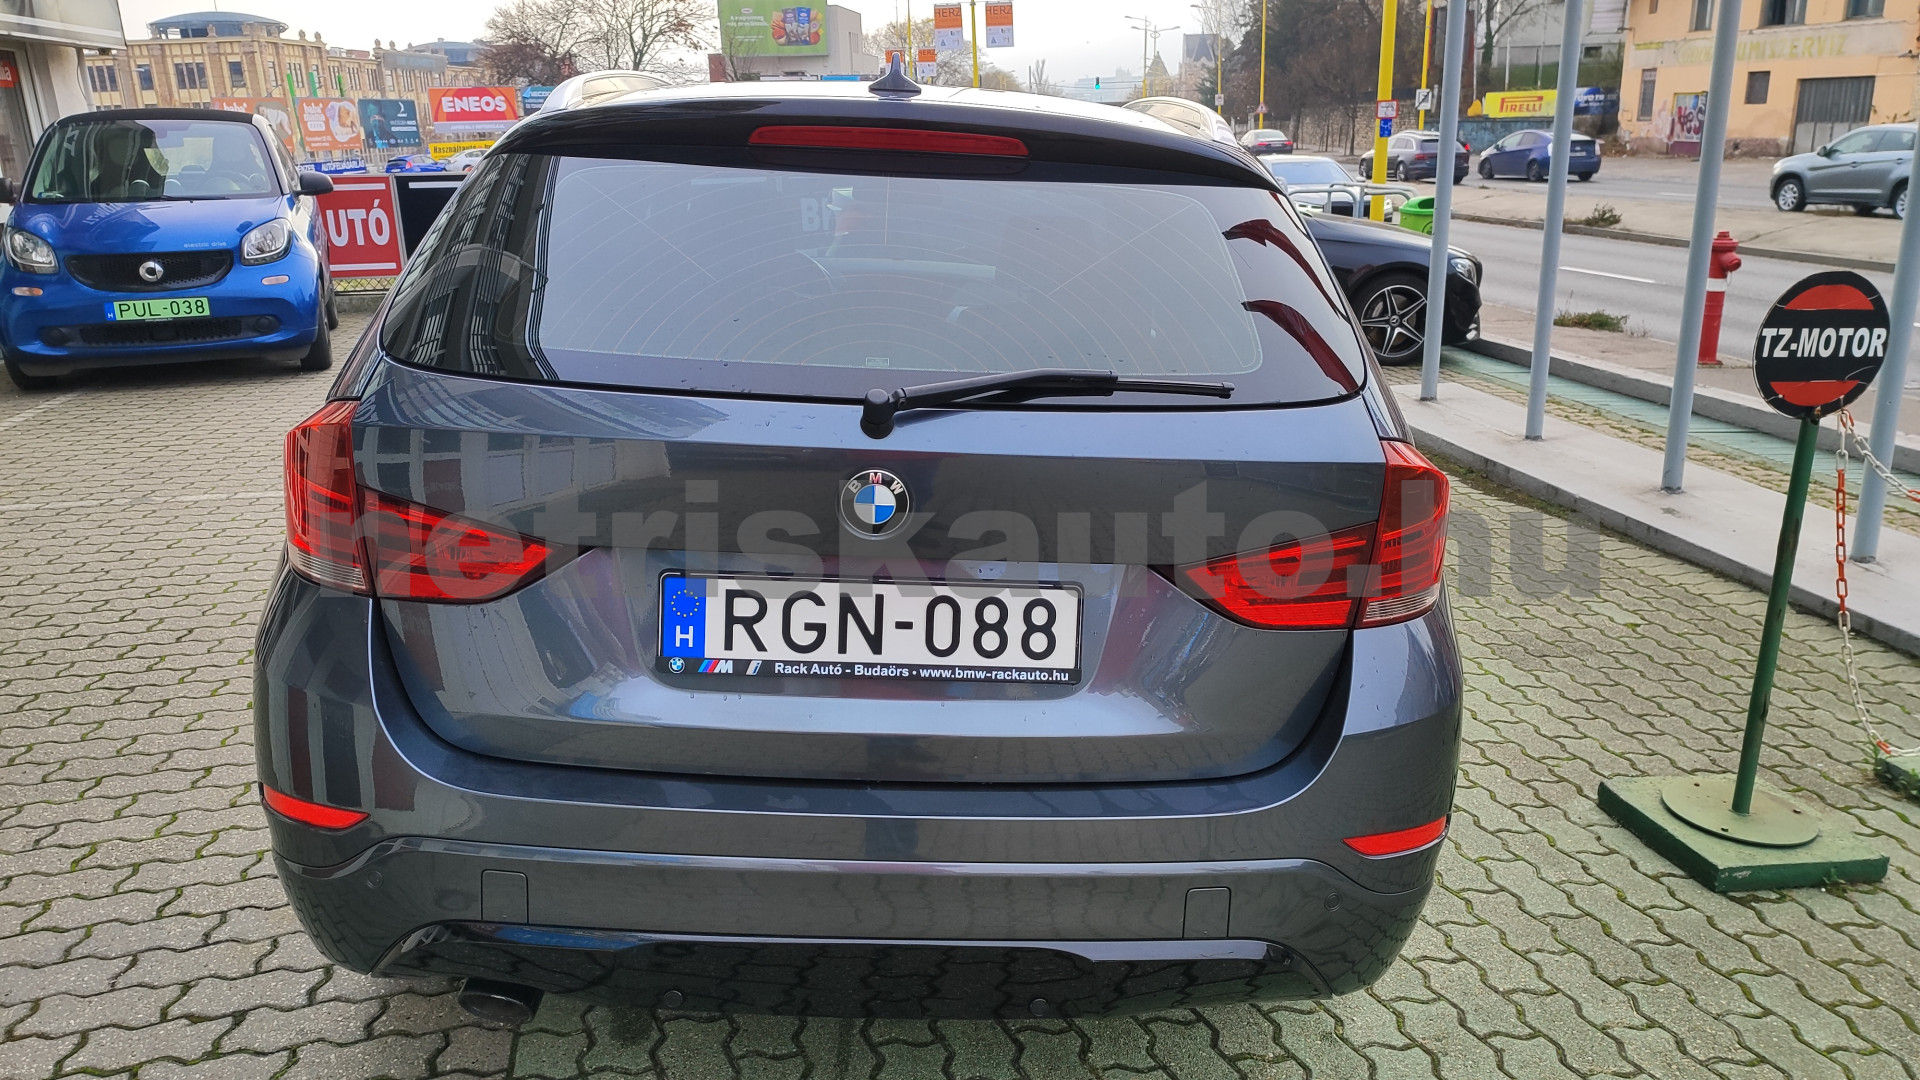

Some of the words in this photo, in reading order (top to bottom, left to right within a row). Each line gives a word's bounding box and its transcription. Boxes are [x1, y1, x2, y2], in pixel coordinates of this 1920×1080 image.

[986, 5, 1012, 15] HERZ
[1737, 34, 1848, 61] UMISZERVIZ
[442, 96, 507, 113] ENEOS
[1499, 96, 1544, 113] PIRELLI
[326, 199, 390, 247] UTÓ
[118, 300, 205, 318] PUL-038
[1761, 327, 1887, 358] TZ-MOTOR
[847, 472, 904, 495] BMW
[675, 624, 694, 648] H
[724, 588, 1057, 661] RGN-088
[774, 662, 807, 675] Rack
[810, 663, 842, 676] Autó
[854, 664, 909, 677] Budaörs
[919, 667, 1069, 682] www.bmw-rackauto.hu
